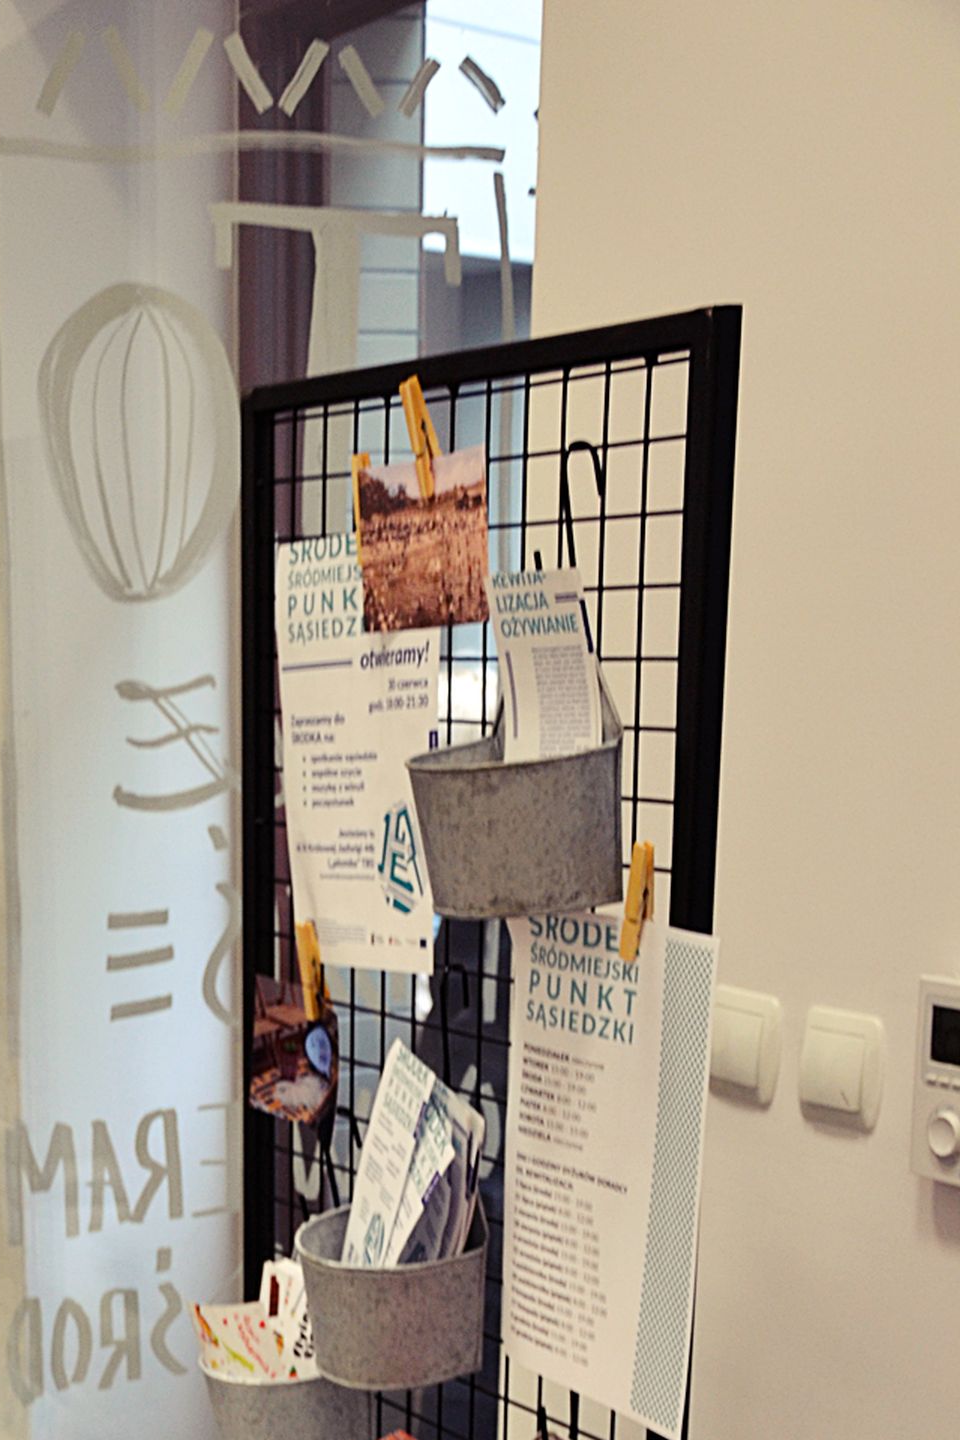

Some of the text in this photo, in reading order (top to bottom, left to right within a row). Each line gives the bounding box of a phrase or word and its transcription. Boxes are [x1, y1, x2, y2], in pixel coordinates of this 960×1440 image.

[287, 564, 363, 592] ŚRÓDMIEJS
[288, 587, 359, 617] PUNK
[496, 592, 550, 613] LIZACJA
[288, 615, 365, 645] SĄSIEDZ
[500, 612, 579, 638] OŻYWIANIE
[360, 639, 430, 670] otwieramy!
[531, 941, 639, 985] ŚRÓDMIEJSKI
[528, 968, 638, 1017] PUNKT
[526, 1000, 635, 1046] SĄSIEDZKI
